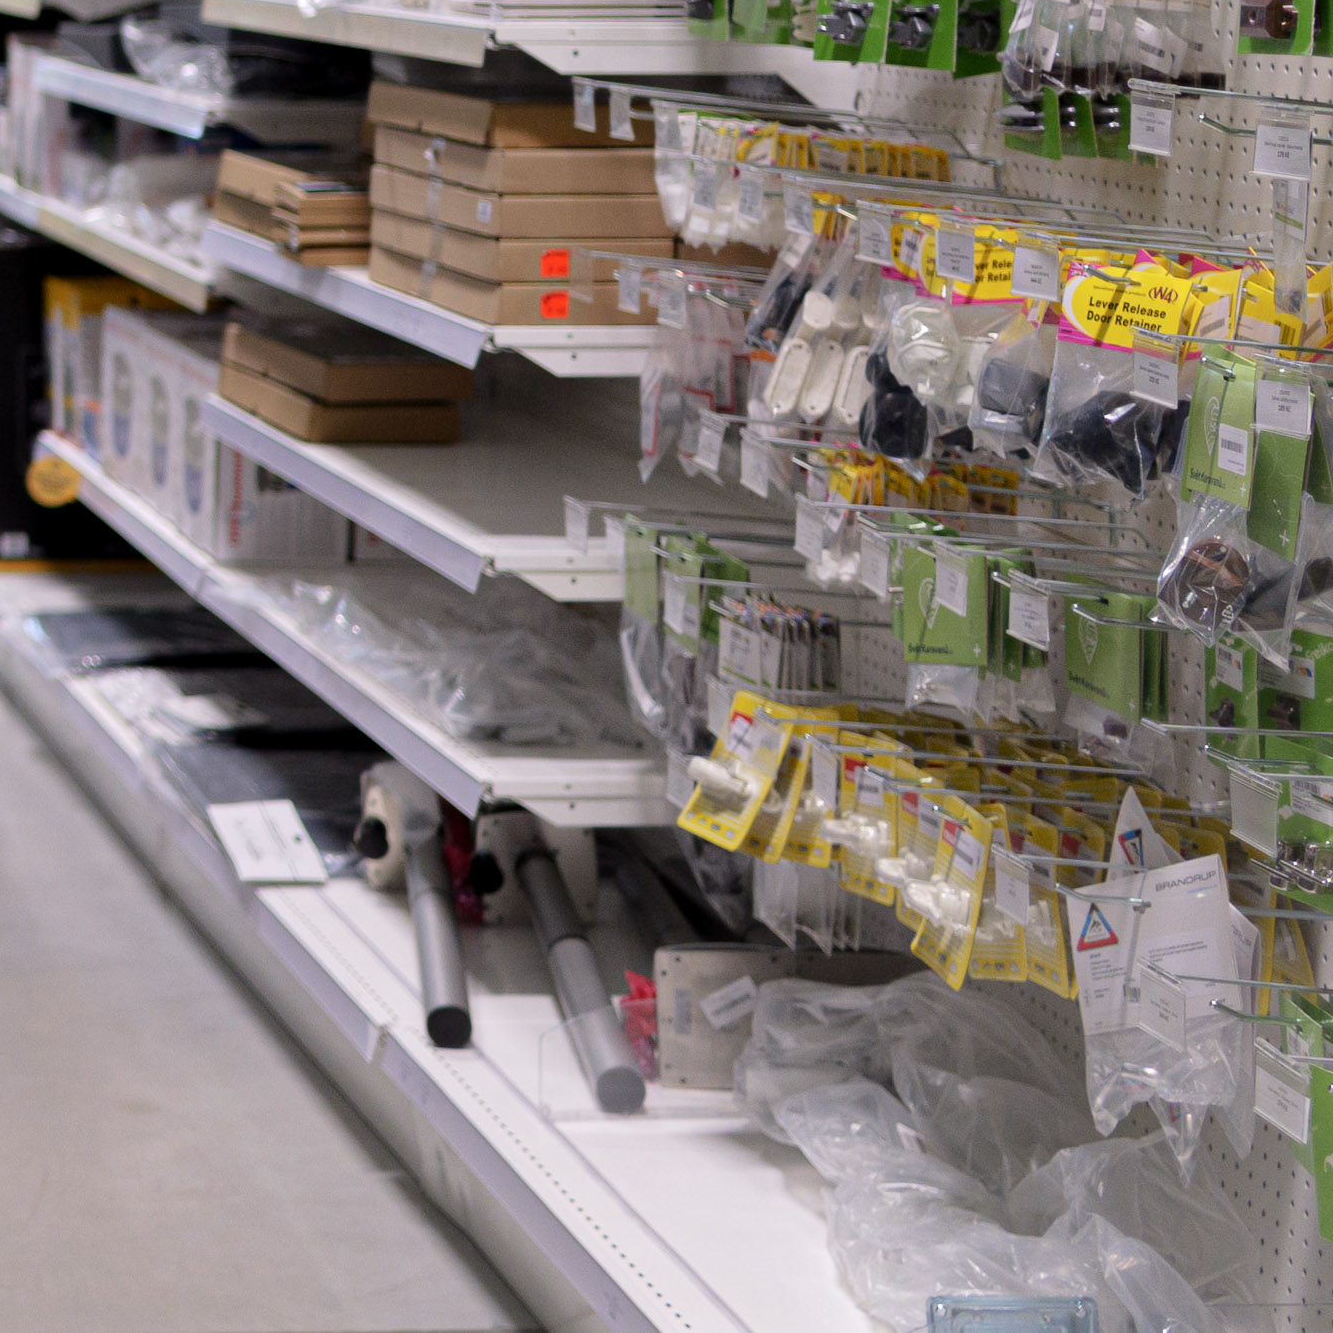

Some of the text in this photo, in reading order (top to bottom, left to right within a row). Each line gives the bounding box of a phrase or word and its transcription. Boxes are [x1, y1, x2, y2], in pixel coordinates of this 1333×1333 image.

[1089, 296, 1167, 319] Lever Release
[1087, 310, 1162, 333] Door Retainer
[1155, 870, 1216, 892] BRANDRUP
